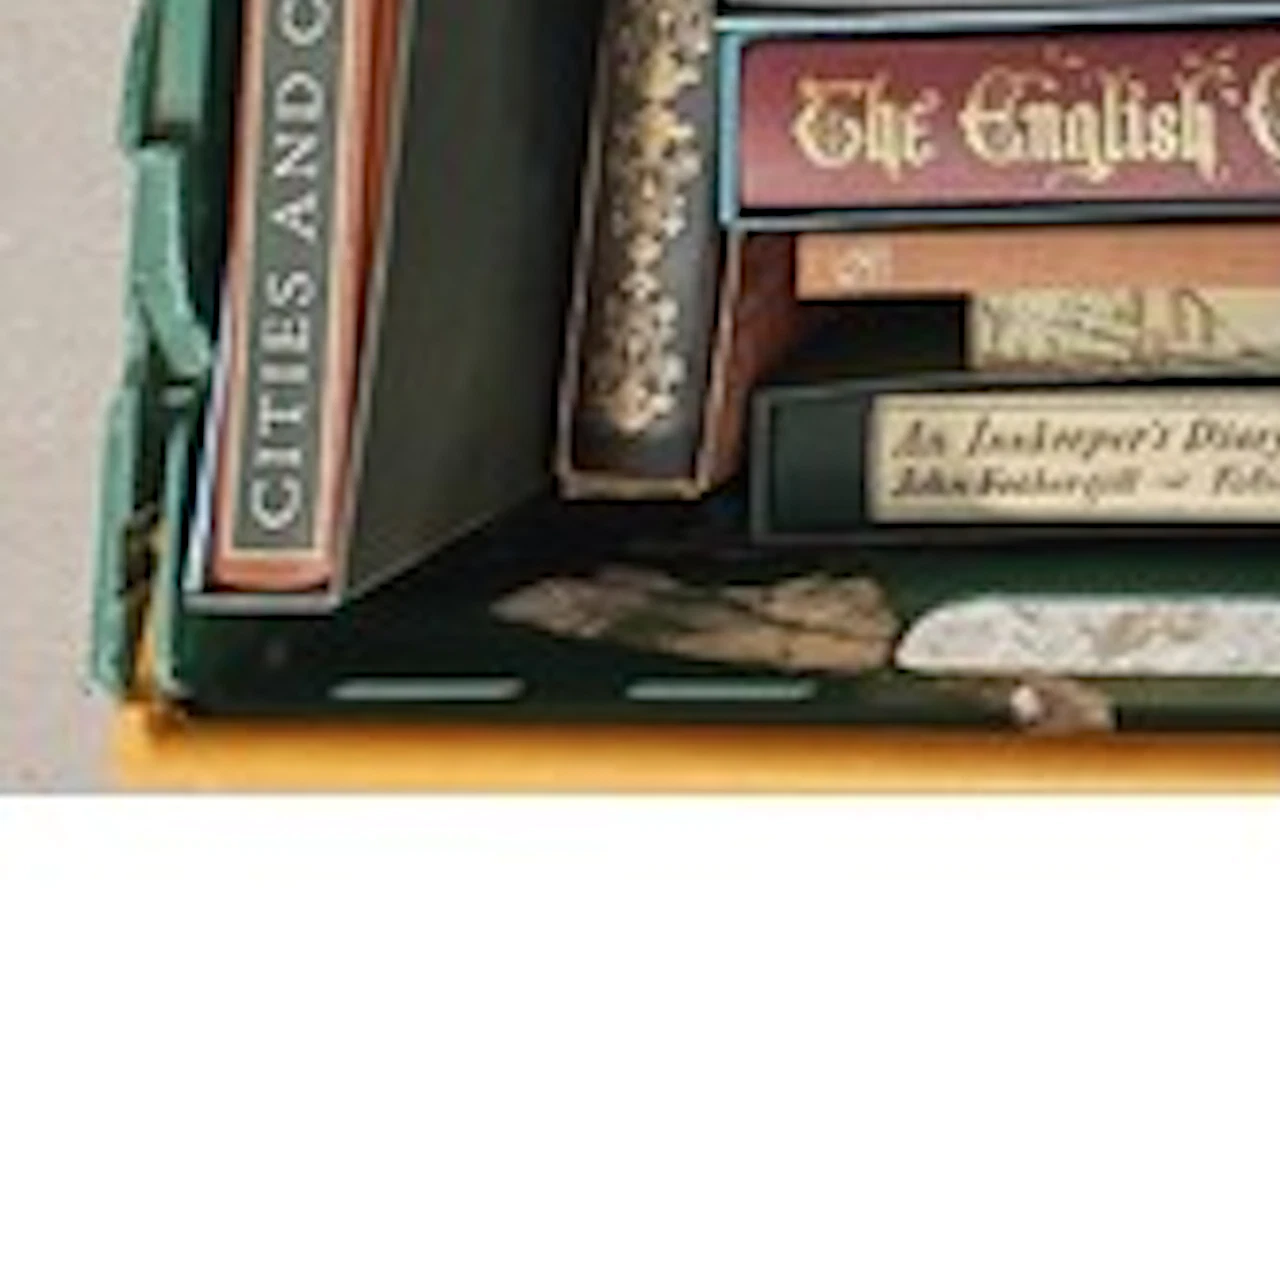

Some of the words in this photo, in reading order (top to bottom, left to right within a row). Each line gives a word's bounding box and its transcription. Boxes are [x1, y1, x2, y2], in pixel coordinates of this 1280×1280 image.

[270, 69, 327, 242] AND
[790, 75, 939, 171] The
[956, 57, 1220, 182] English
[248, 269, 318, 531] CITIES
[890, 418, 947, 460] An
